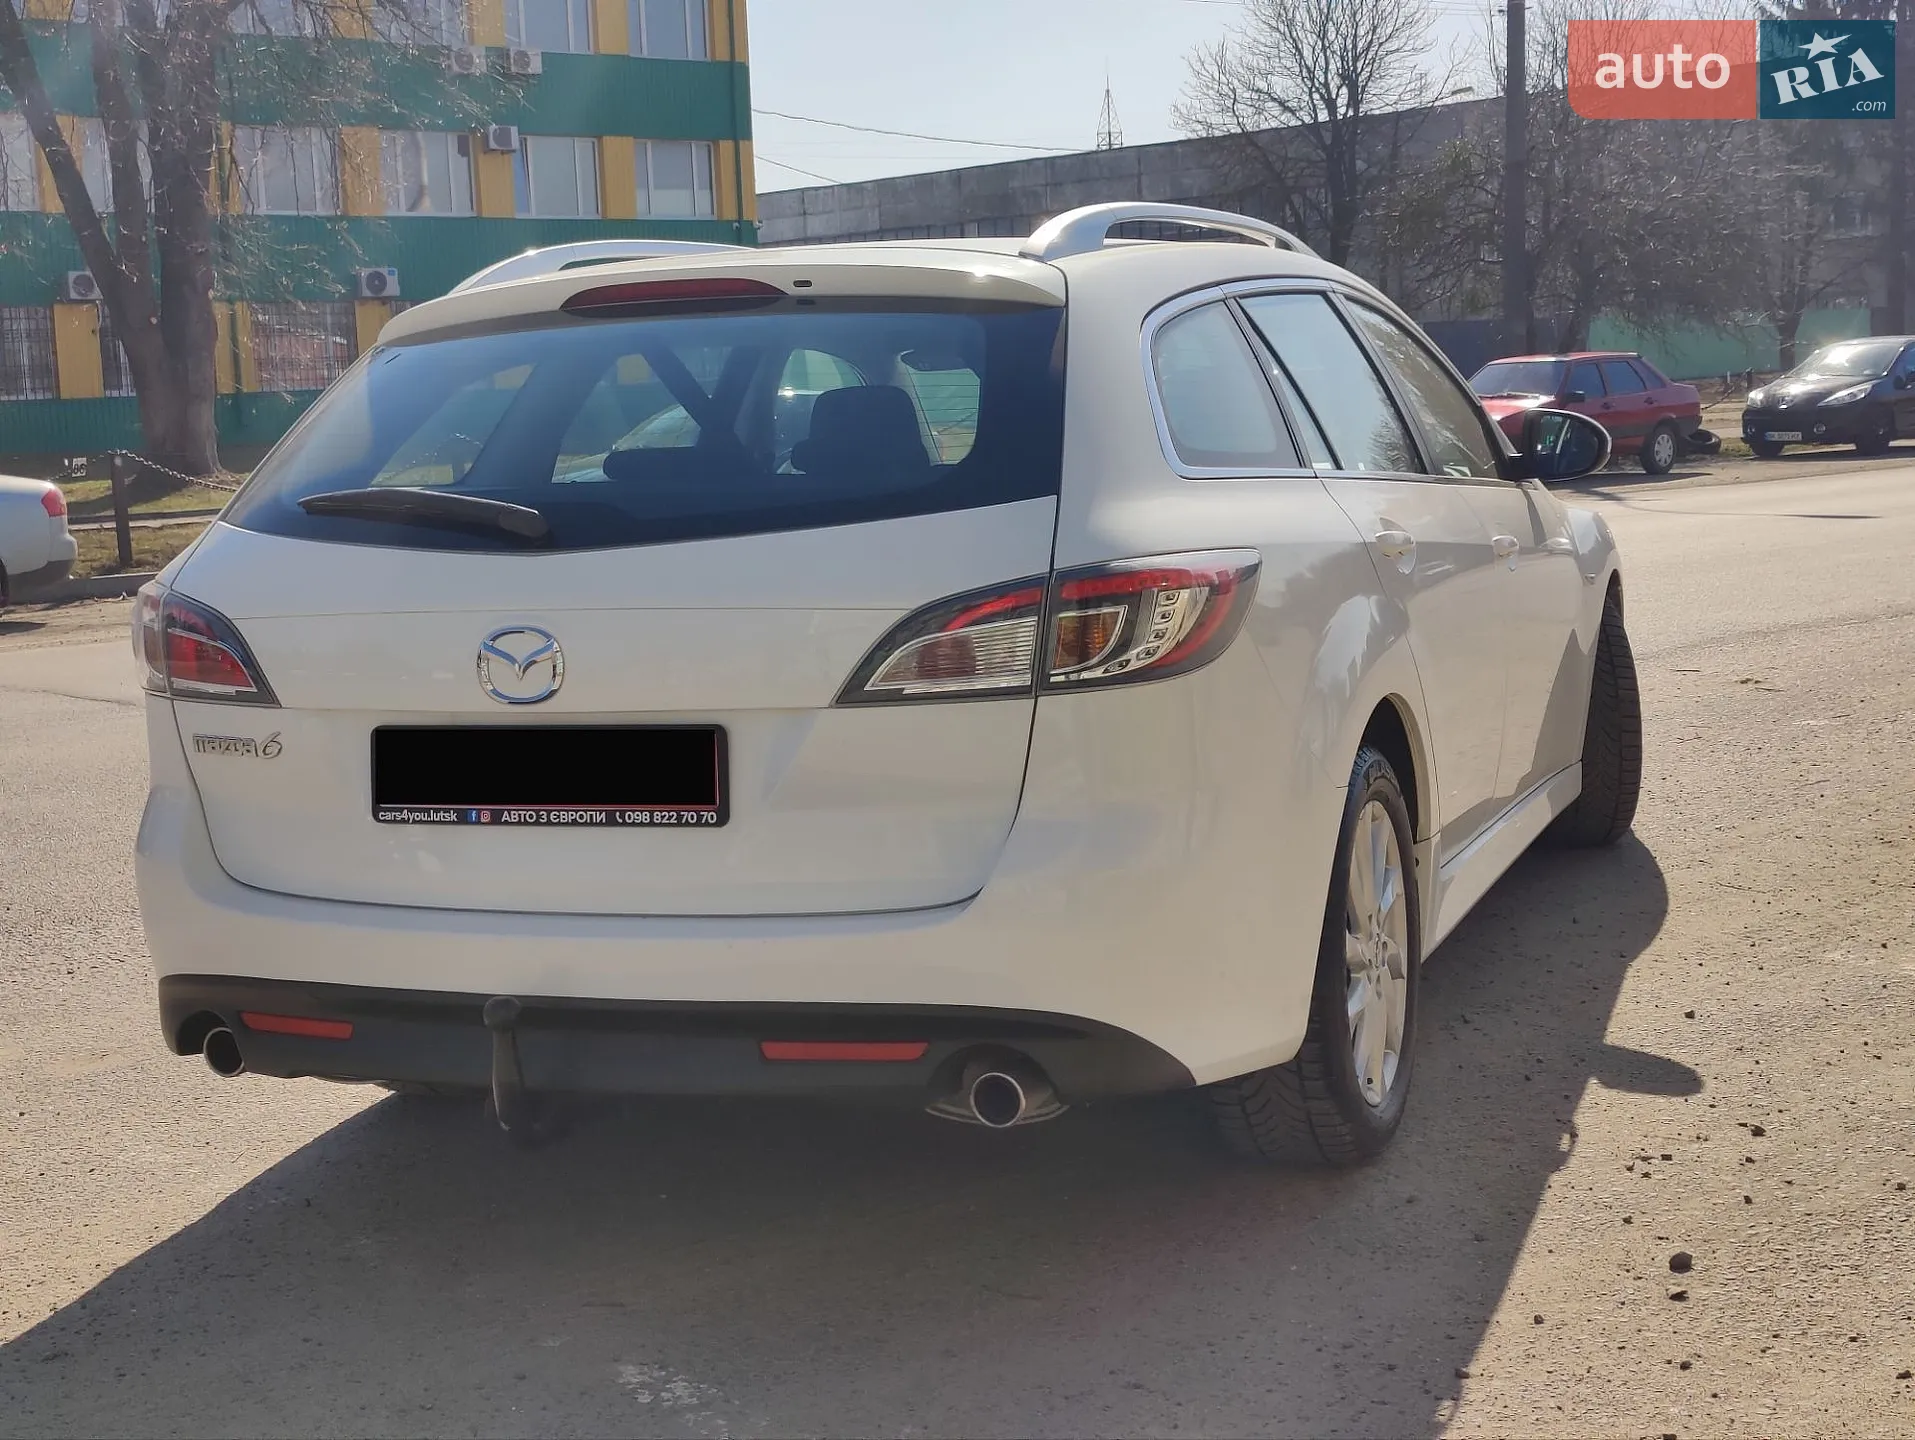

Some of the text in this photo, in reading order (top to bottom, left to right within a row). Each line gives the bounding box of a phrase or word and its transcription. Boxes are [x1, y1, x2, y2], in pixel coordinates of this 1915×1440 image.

[378, 809, 458, 824] cars4you.lutsk
[501, 811, 537, 823] АВТО
[550, 811, 606, 823] ЄВРОПИ
[625, 811, 650, 823] 098
[653, 811, 677, 824] 822
[680, 811, 697, 824] 70
[700, 811, 717, 824] 70
